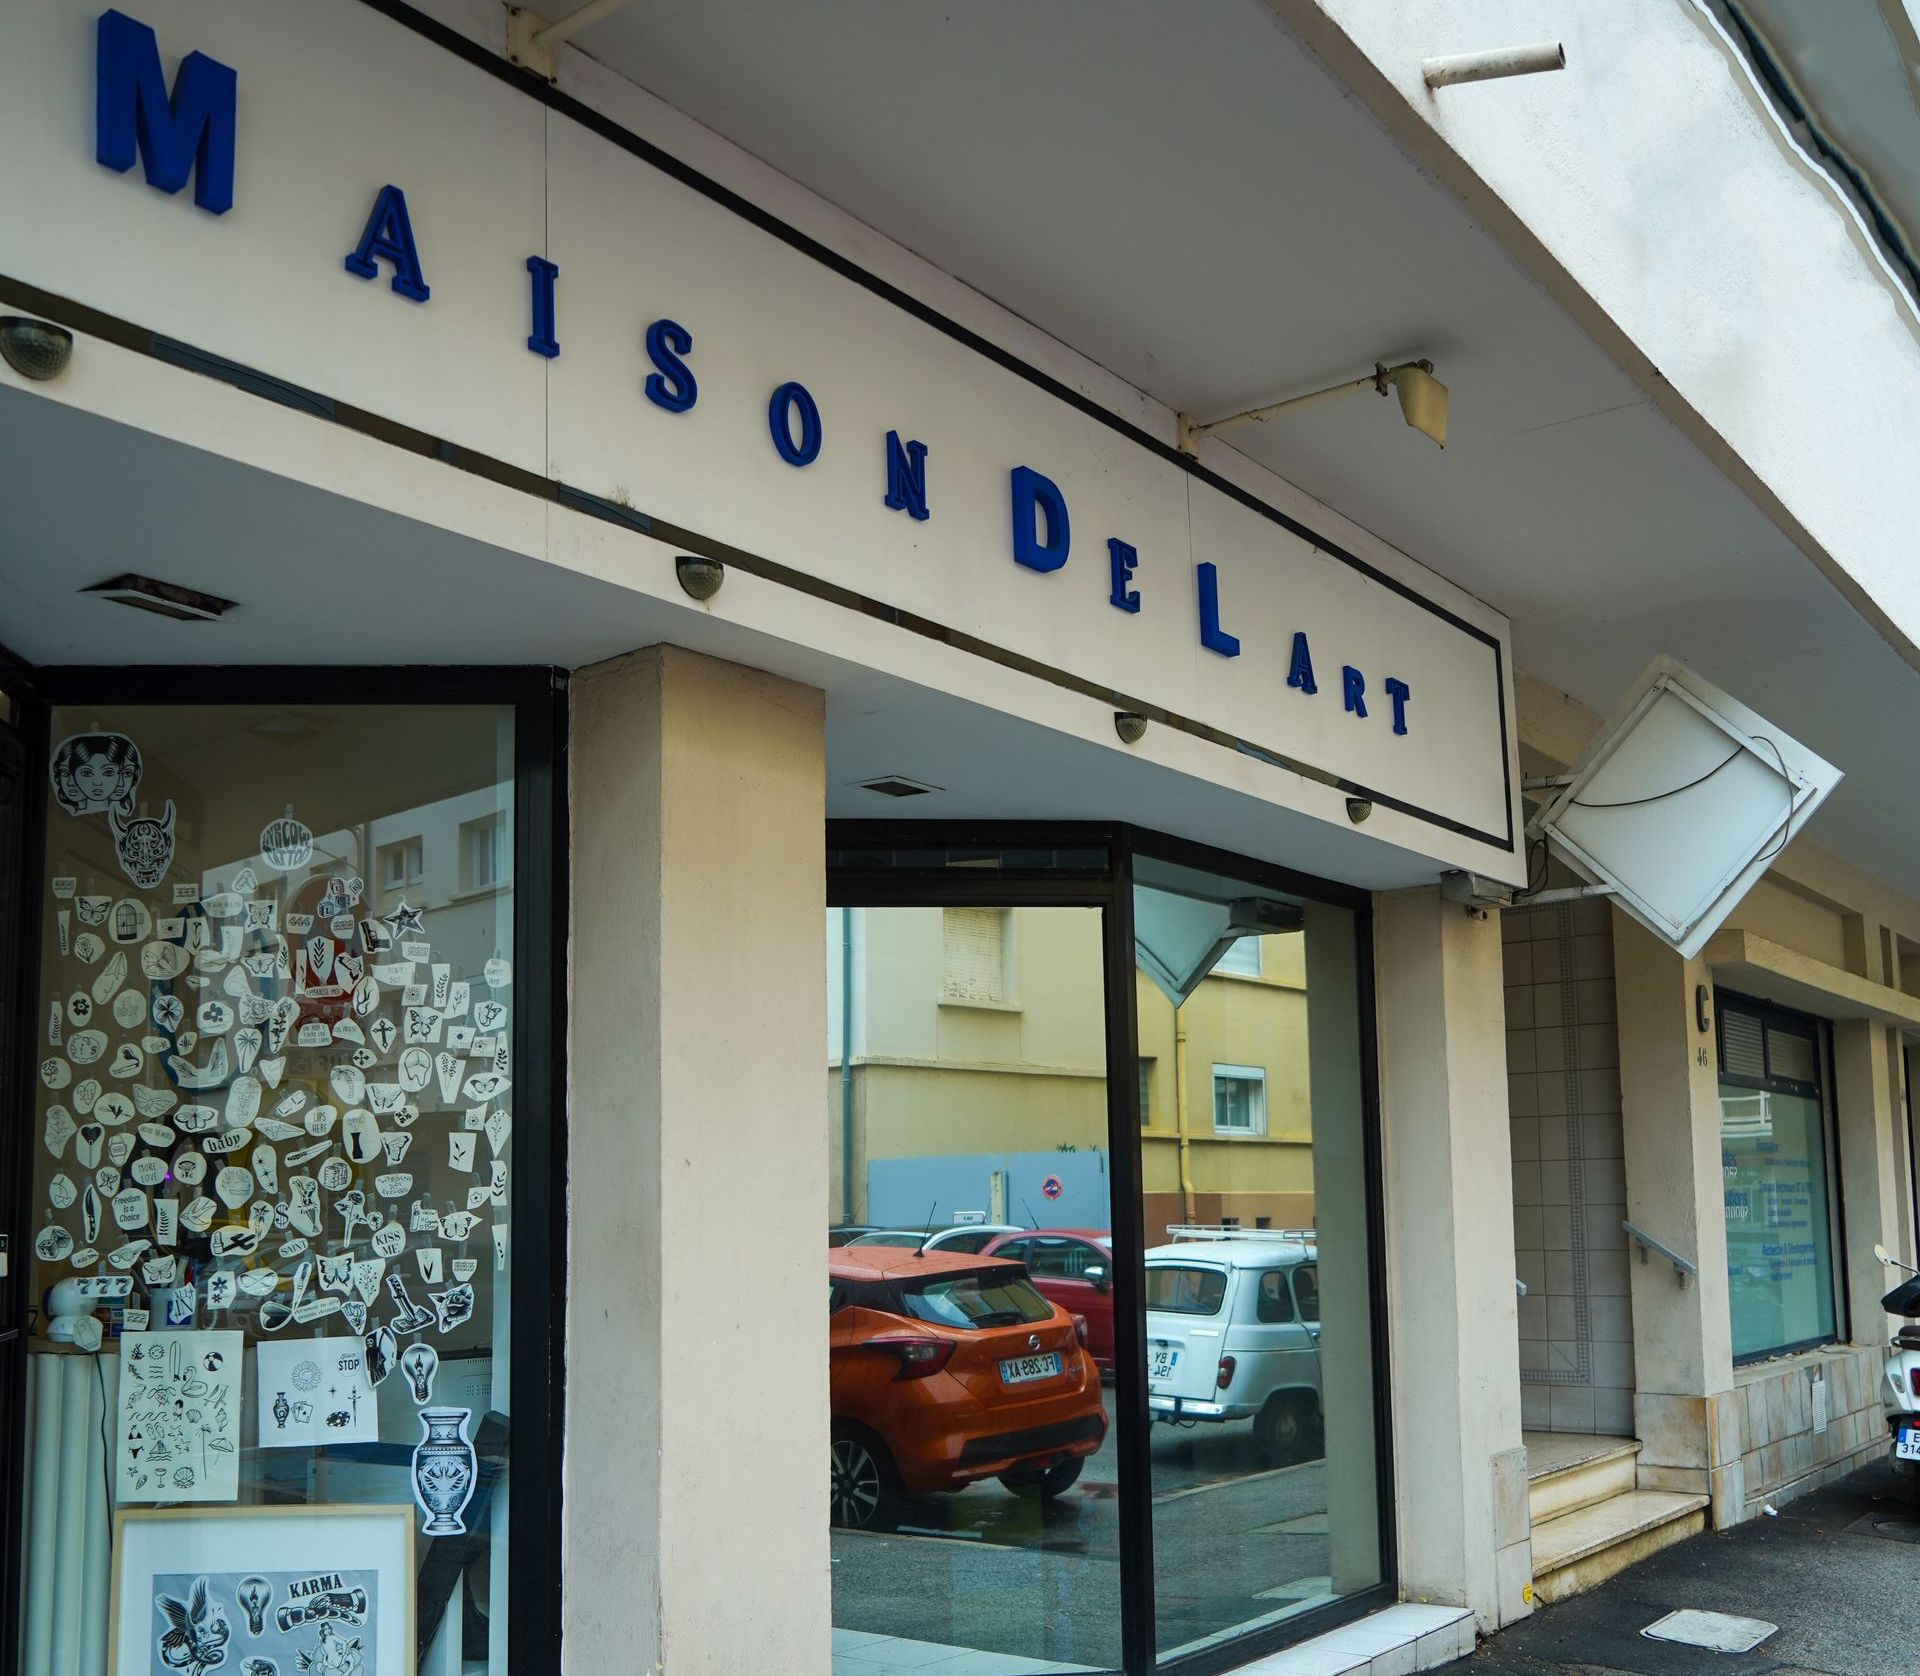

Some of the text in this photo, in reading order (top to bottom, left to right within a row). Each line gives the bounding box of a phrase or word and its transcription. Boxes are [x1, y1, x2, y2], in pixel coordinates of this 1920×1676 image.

[96, 8, 930, 521] MAISON
[1696, 1046, 1708, 1066] 46
[207, 1134, 240, 1152] baby
[138, 1163, 157, 1172] MORE
[140, 1173, 158, 1183] LOVE
[114, 1194, 141, 1205] Freedom
[123, 1205, 129, 1213] is
[119, 1213, 141, 1223] Choice
[375, 1231, 401, 1245] KISS
[280, 1240, 307, 1256] SAINT
[382, 1243, 401, 1256] ME
[77, 1277, 128, 1295] 777
[338, 1359, 360, 1371] STOP
[289, 1573, 343, 1598] KARMA
